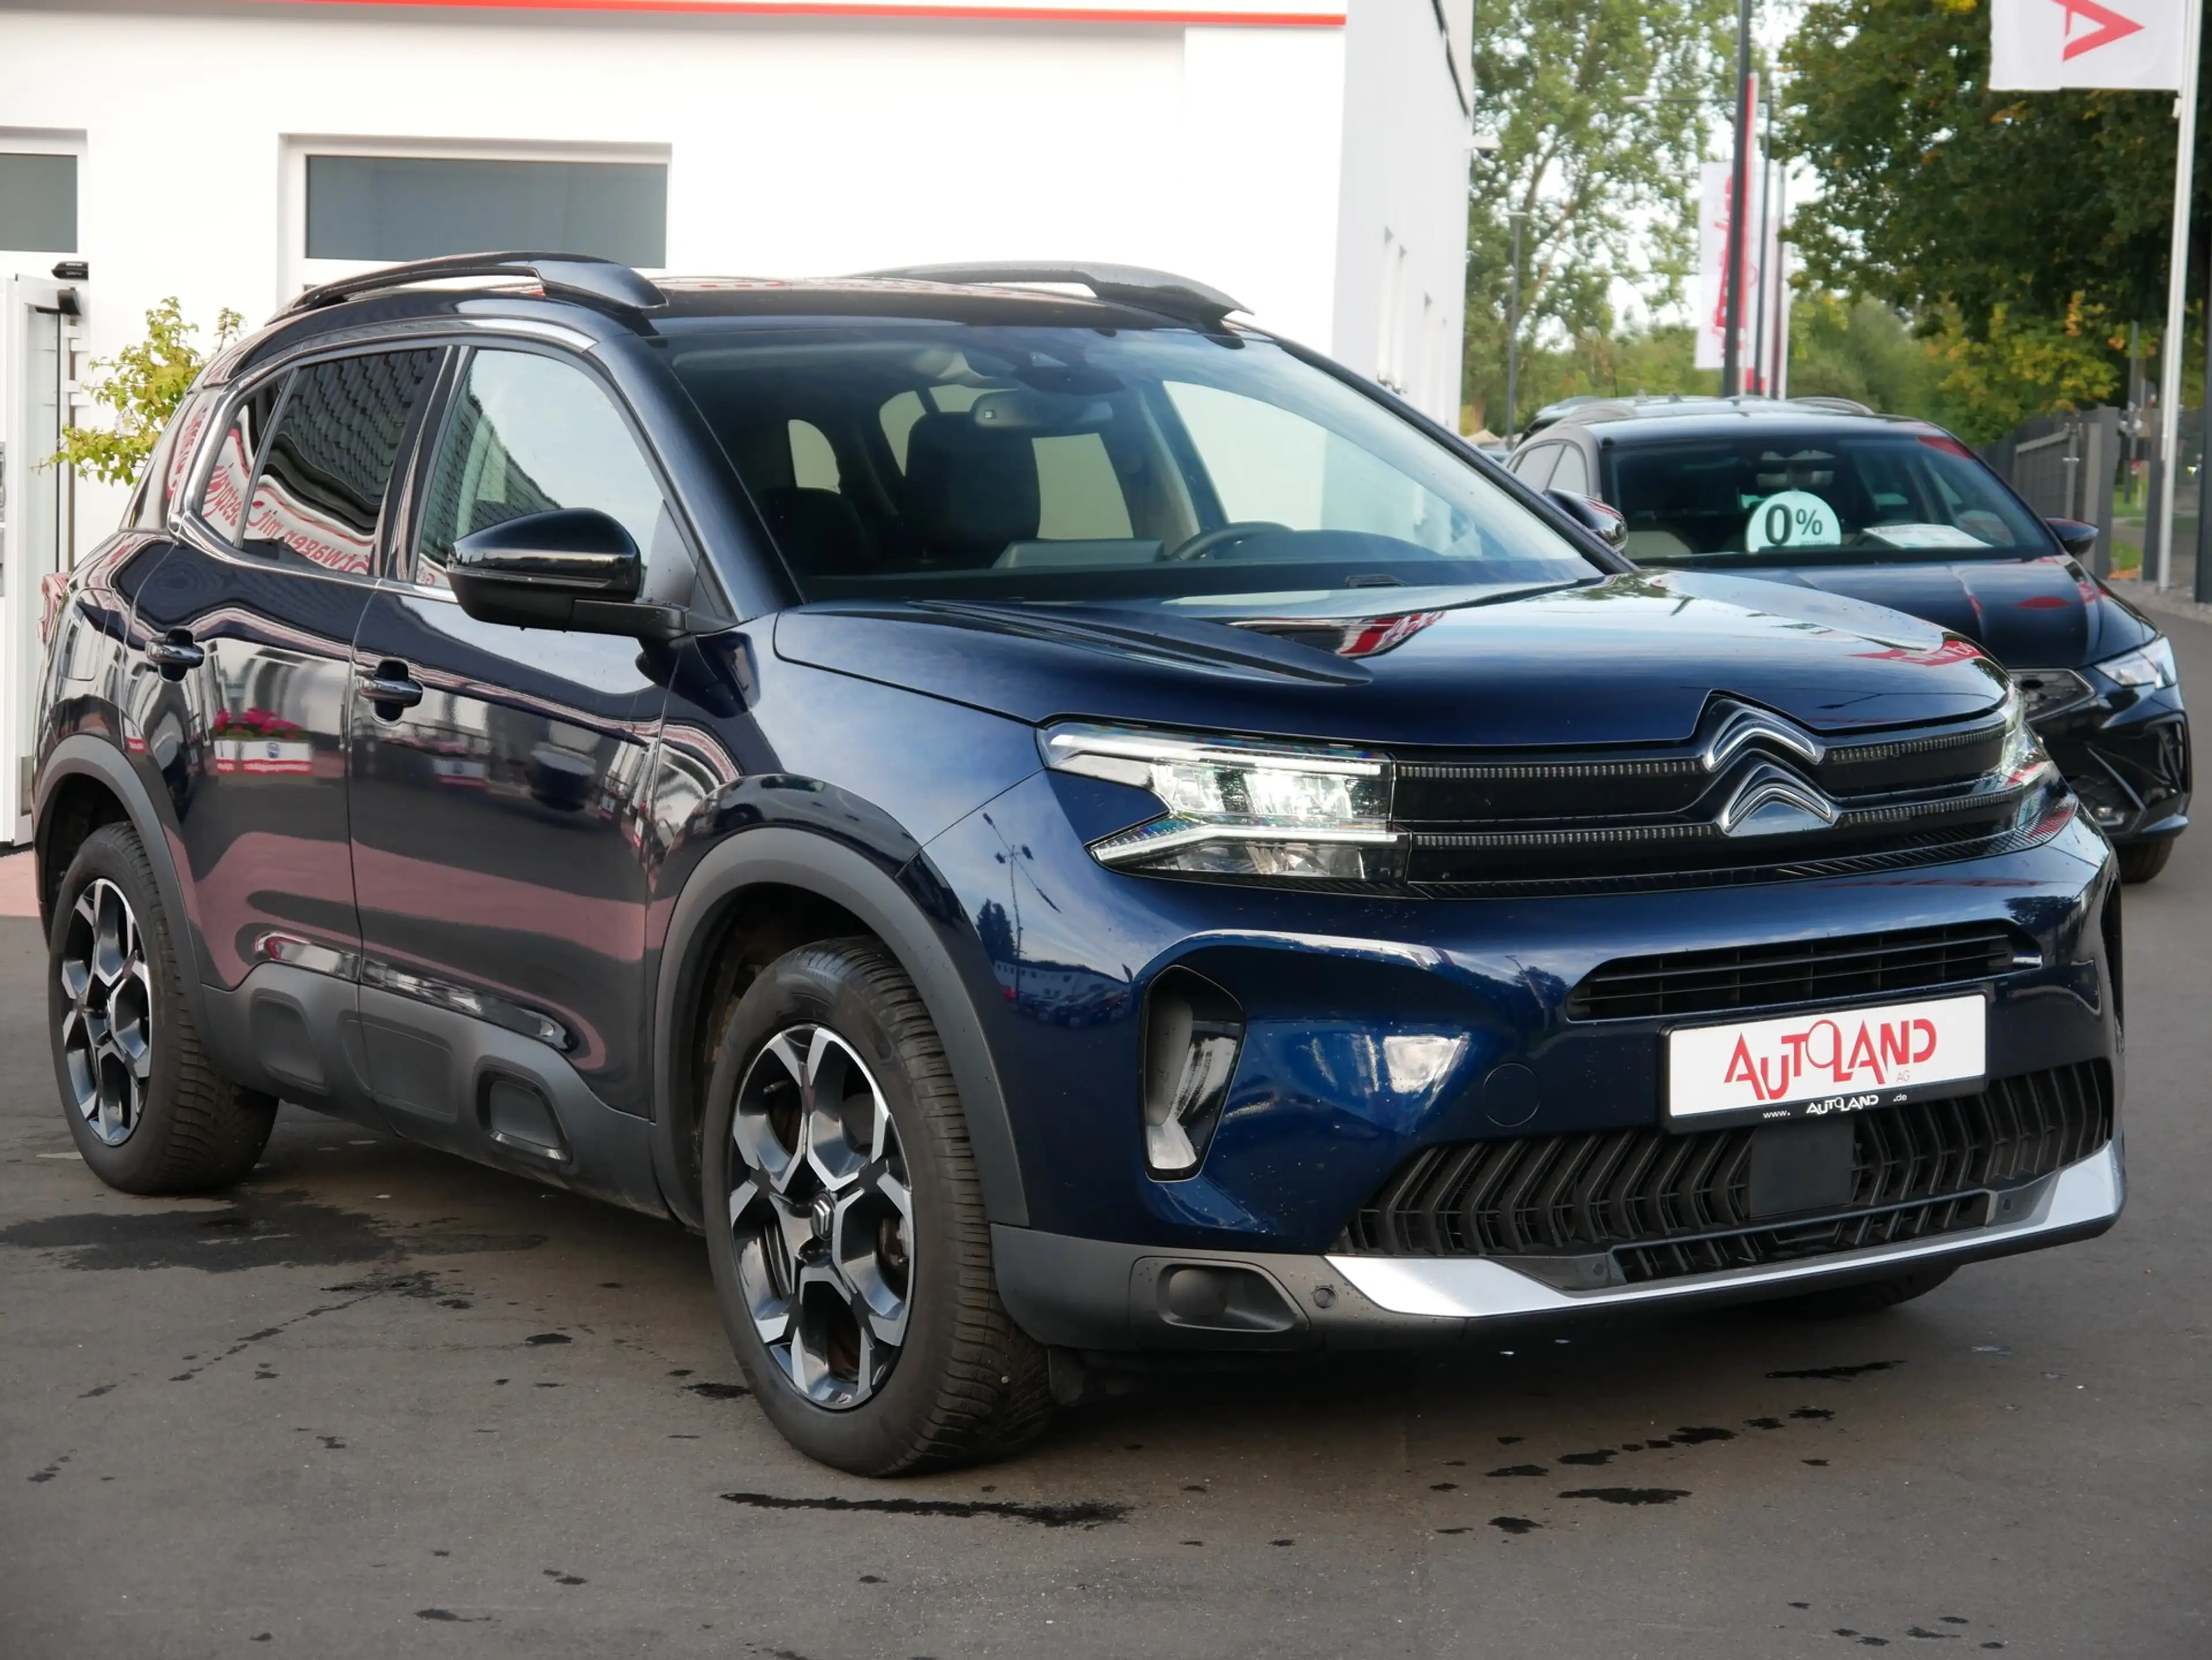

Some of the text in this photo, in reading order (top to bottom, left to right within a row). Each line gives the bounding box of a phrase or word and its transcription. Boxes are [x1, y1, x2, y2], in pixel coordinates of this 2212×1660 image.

[1765, 503, 1822, 545] 0%
[1724, 1018, 1936, 1100] AUTOLAND
[1896, 1070, 1910, 1082] AG
[1762, 1094, 1908, 1119] www. AUTOLAND .de
